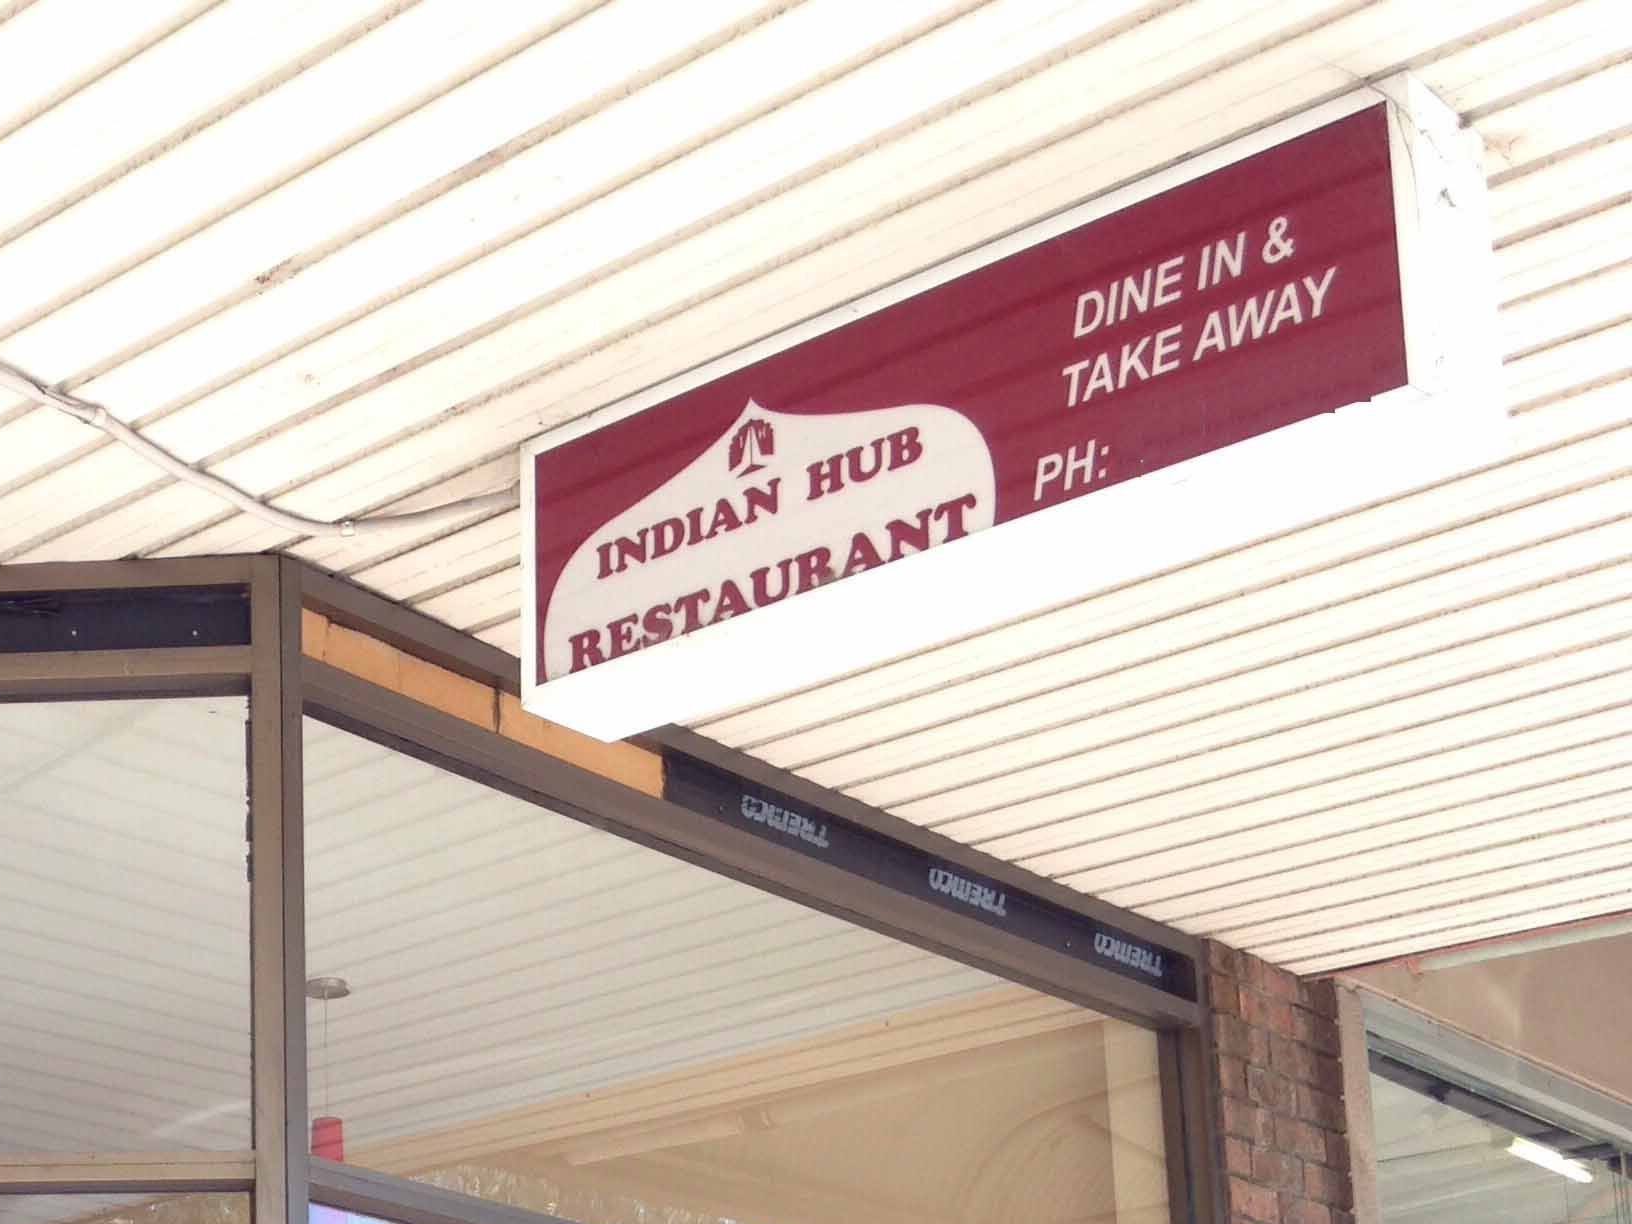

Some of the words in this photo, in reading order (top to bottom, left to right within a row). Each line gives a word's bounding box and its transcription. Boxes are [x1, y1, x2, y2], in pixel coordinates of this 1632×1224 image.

[1074, 256, 1184, 338] DINE
[1197, 232, 1245, 291] IN
[1261, 216, 1295, 264] &
[1062, 324, 1183, 408] TAKE
[1192, 266, 1337, 362] AWAY
[597, 477, 781, 579] INDIAN
[806, 426, 923, 500] HUB
[1033, 439, 1110, 501] PH:
[568, 493, 976, 673] RESTAURANT
[741, 794, 830, 849] TREMCO
[929, 868, 1007, 917] TREMCO
[1094, 932, 1164, 978] TREMCO
